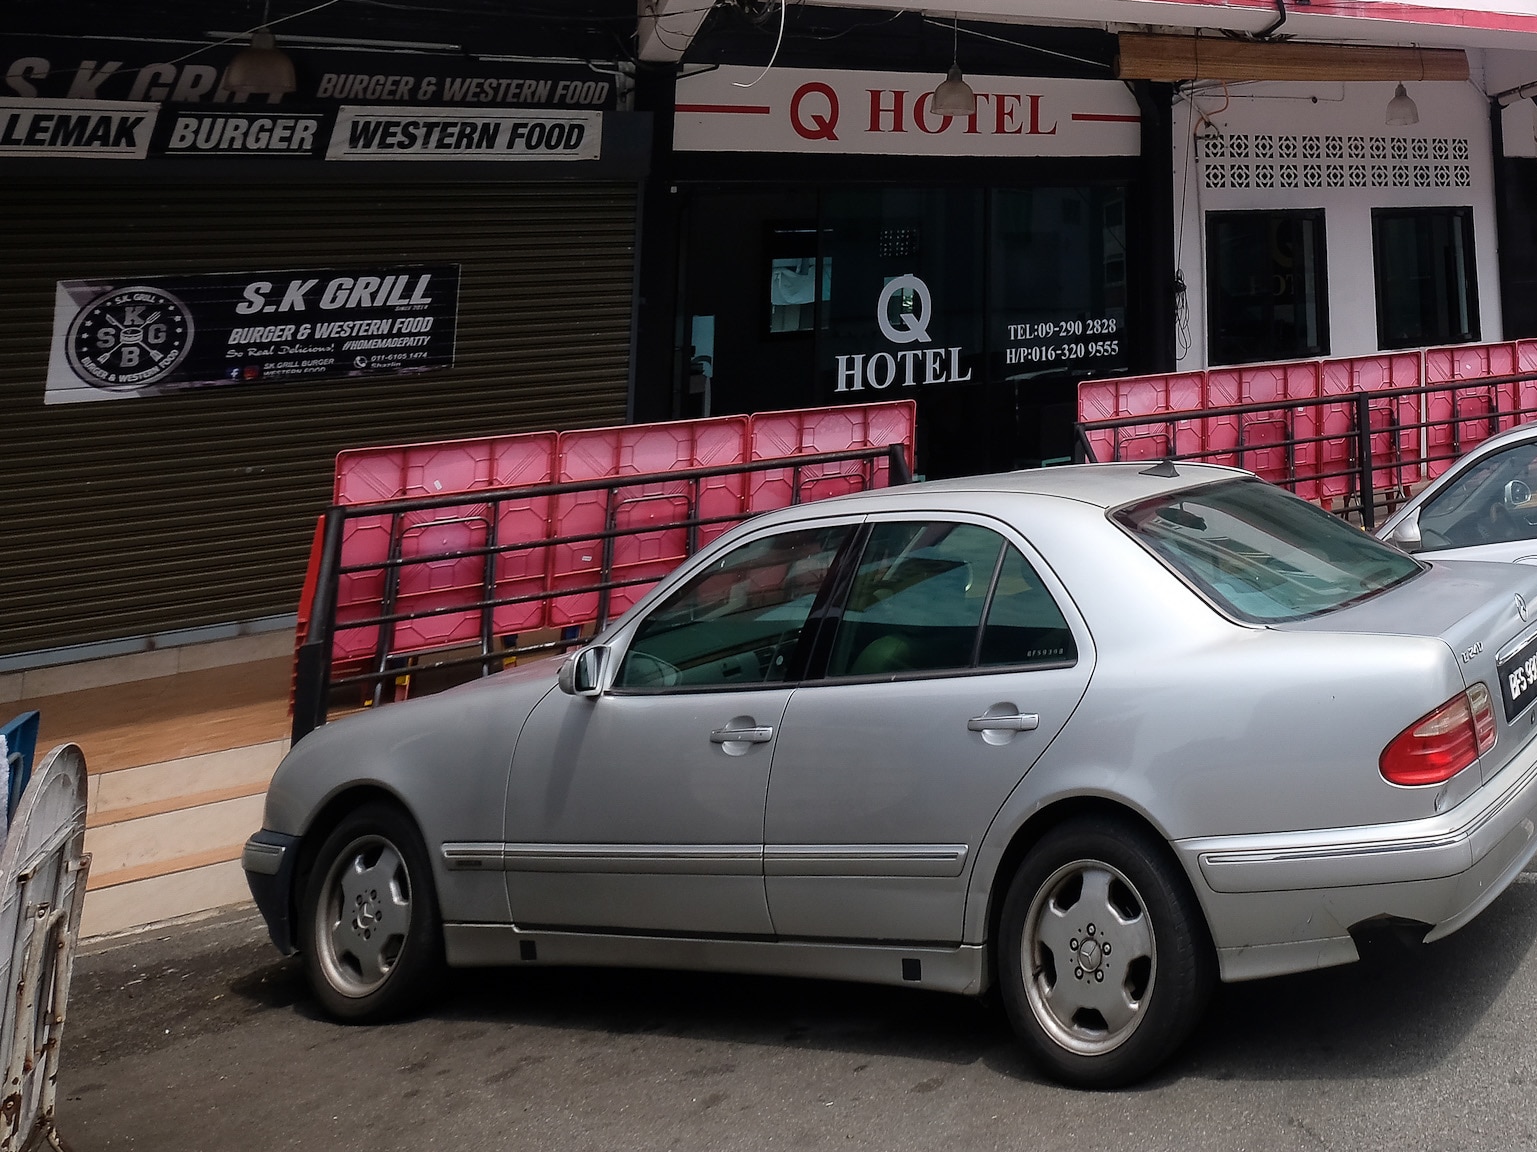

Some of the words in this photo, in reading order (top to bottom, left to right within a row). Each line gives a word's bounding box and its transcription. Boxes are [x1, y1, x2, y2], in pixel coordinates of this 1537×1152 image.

[316, 73, 414, 100] BURGER
[418, 77, 438, 101] &
[443, 77, 551, 104] WESTERN
[552, 80, 610, 105] FOOD
[789, 81, 840, 141] Q
[864, 88, 1058, 136] HOTEL
[1, 113, 147, 148] LEMAK
[168, 116, 318, 150] BURGER
[349, 119, 501, 150] WESTERN
[505, 122, 586, 150] FOOD
[235, 278, 319, 315] S.K
[319, 273, 433, 310] GRILL
[877, 274, 932, 344] Q
[123, 306, 146, 325] K
[228, 324, 296, 345] BURGER
[297, 323, 312, 340] &
[314, 318, 393, 339] WESTERN
[392, 316, 434, 334] FOOD
[1007, 320, 1083, 340] TEL:09-290
[1085, 318, 1117, 335] 2828
[96, 327, 116, 348] S
[147, 323, 167, 344] G
[247, 345, 275, 357] Real
[120, 346, 141, 368] B
[1006, 342, 1085, 364] H/P:016-320
[1088, 340, 1119, 357] 9555
[834, 347, 972, 393] HOTEL
